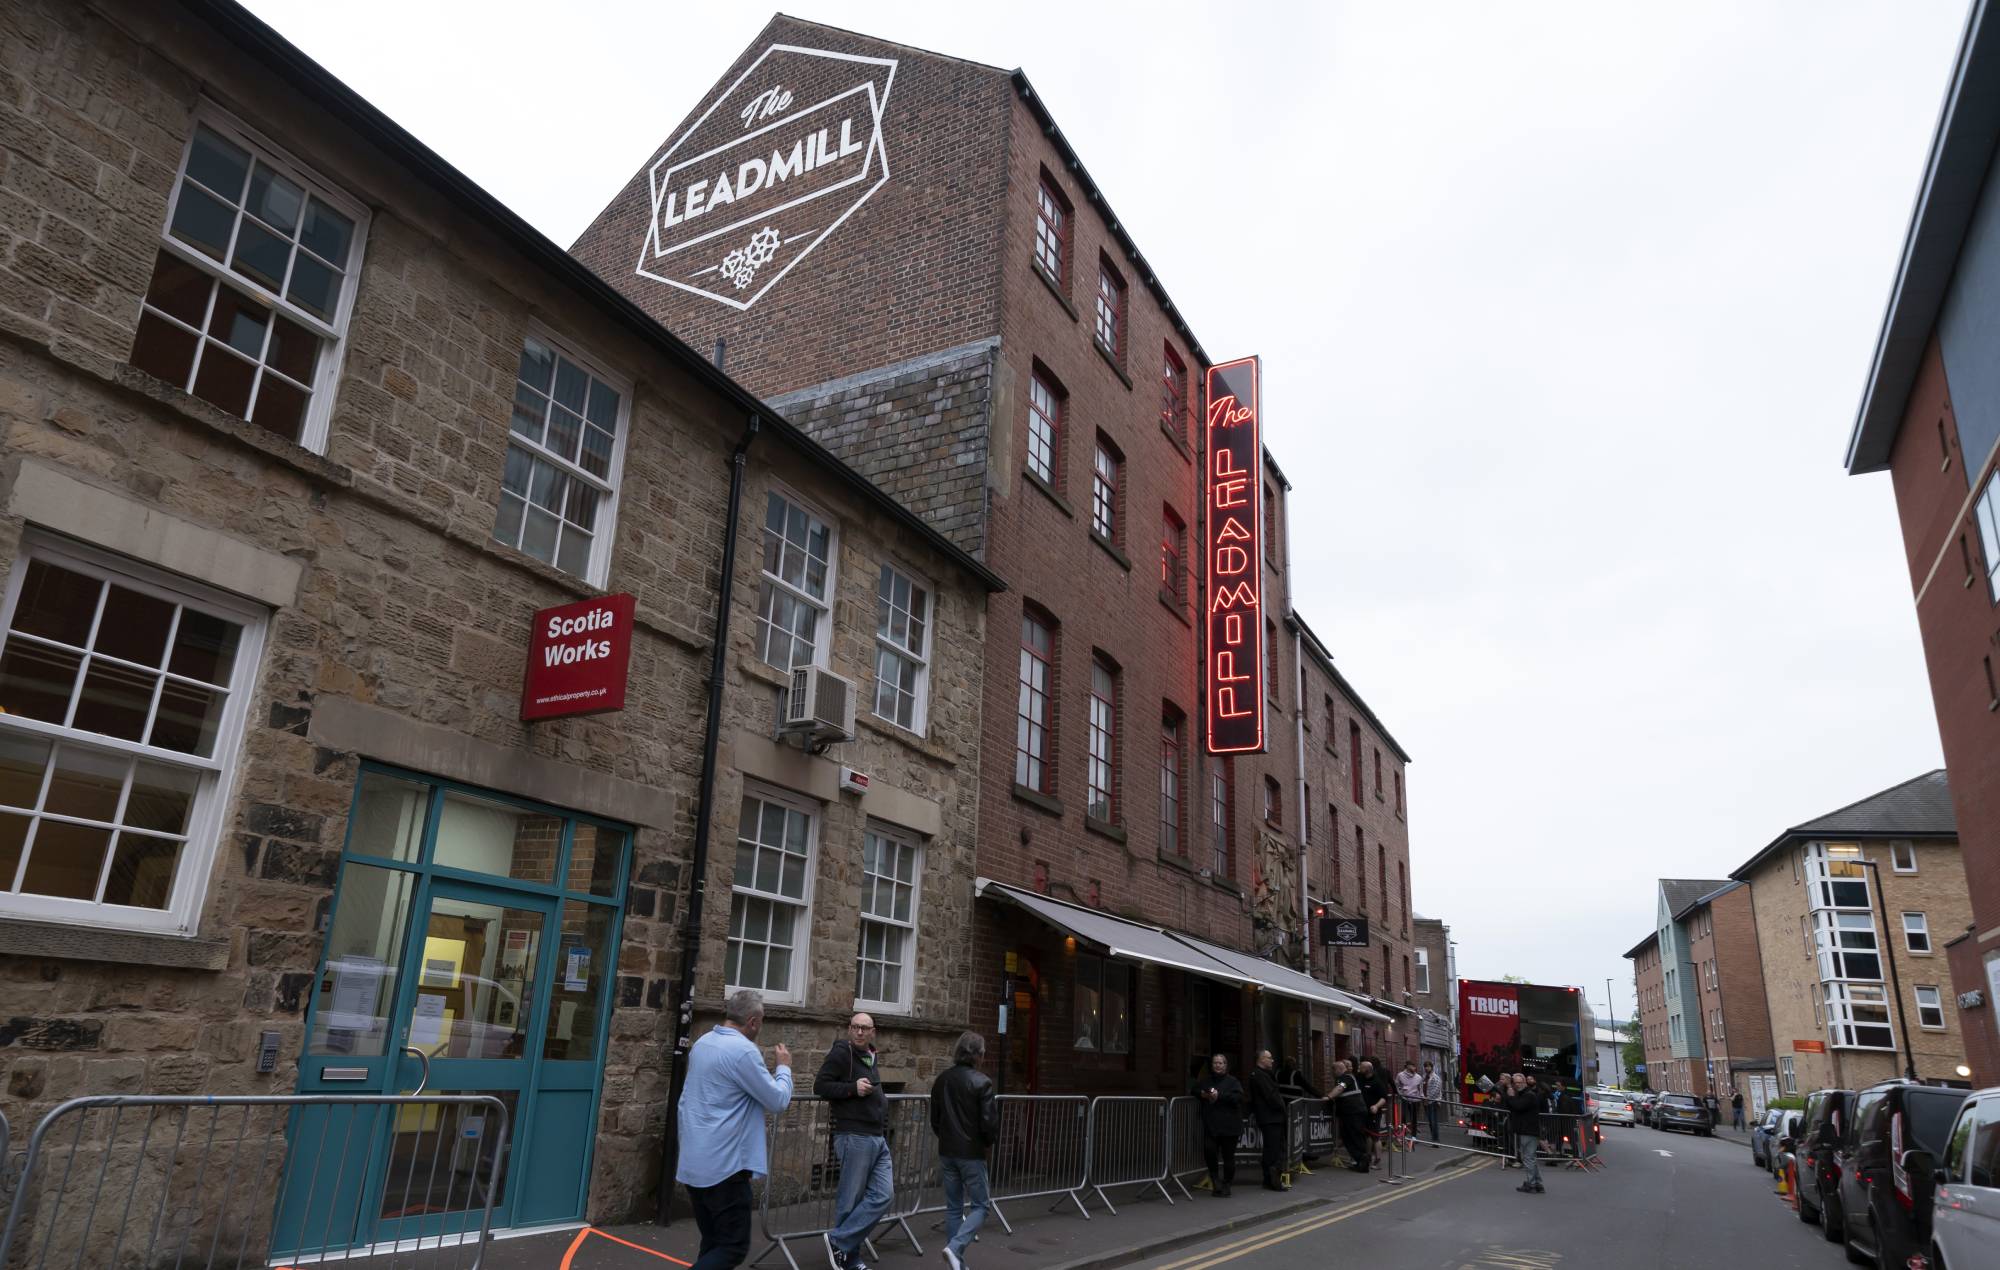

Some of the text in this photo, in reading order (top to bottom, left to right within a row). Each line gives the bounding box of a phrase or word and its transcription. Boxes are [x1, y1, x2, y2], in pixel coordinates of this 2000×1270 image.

[740, 84, 794, 129] The
[664, 118, 863, 228] LEADMILL
[1209, 395, 1253, 427] The
[1212, 448, 1256, 718] LEADMILL
[547, 608, 614, 639] Scotia
[544, 639, 611, 667] Works
